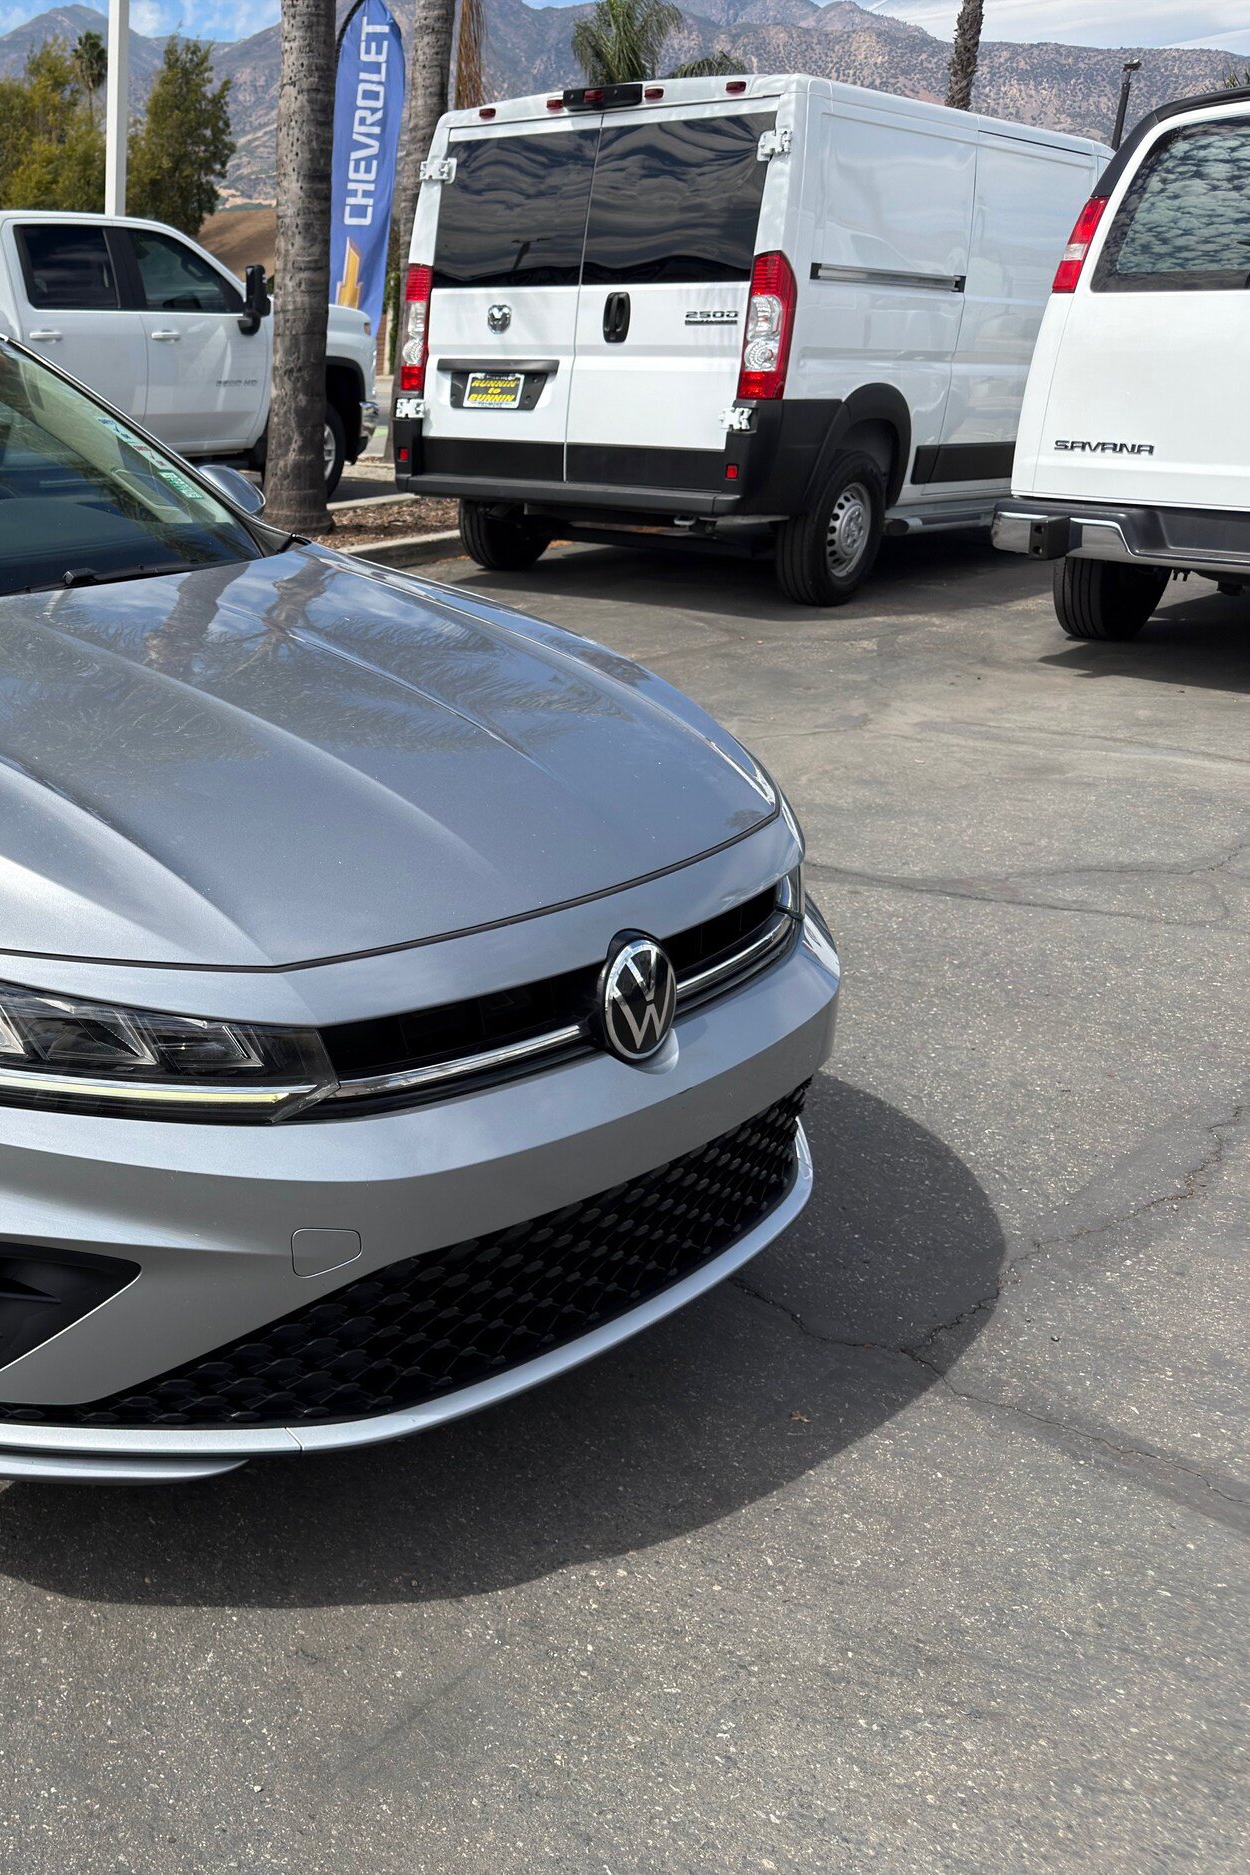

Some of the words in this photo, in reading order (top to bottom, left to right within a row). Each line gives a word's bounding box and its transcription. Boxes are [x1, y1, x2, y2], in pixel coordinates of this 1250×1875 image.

[344, 16, 390, 226] CHEVROLET
[685, 310, 739, 319] 2500
[1054, 440, 1155, 456] SAVANA
